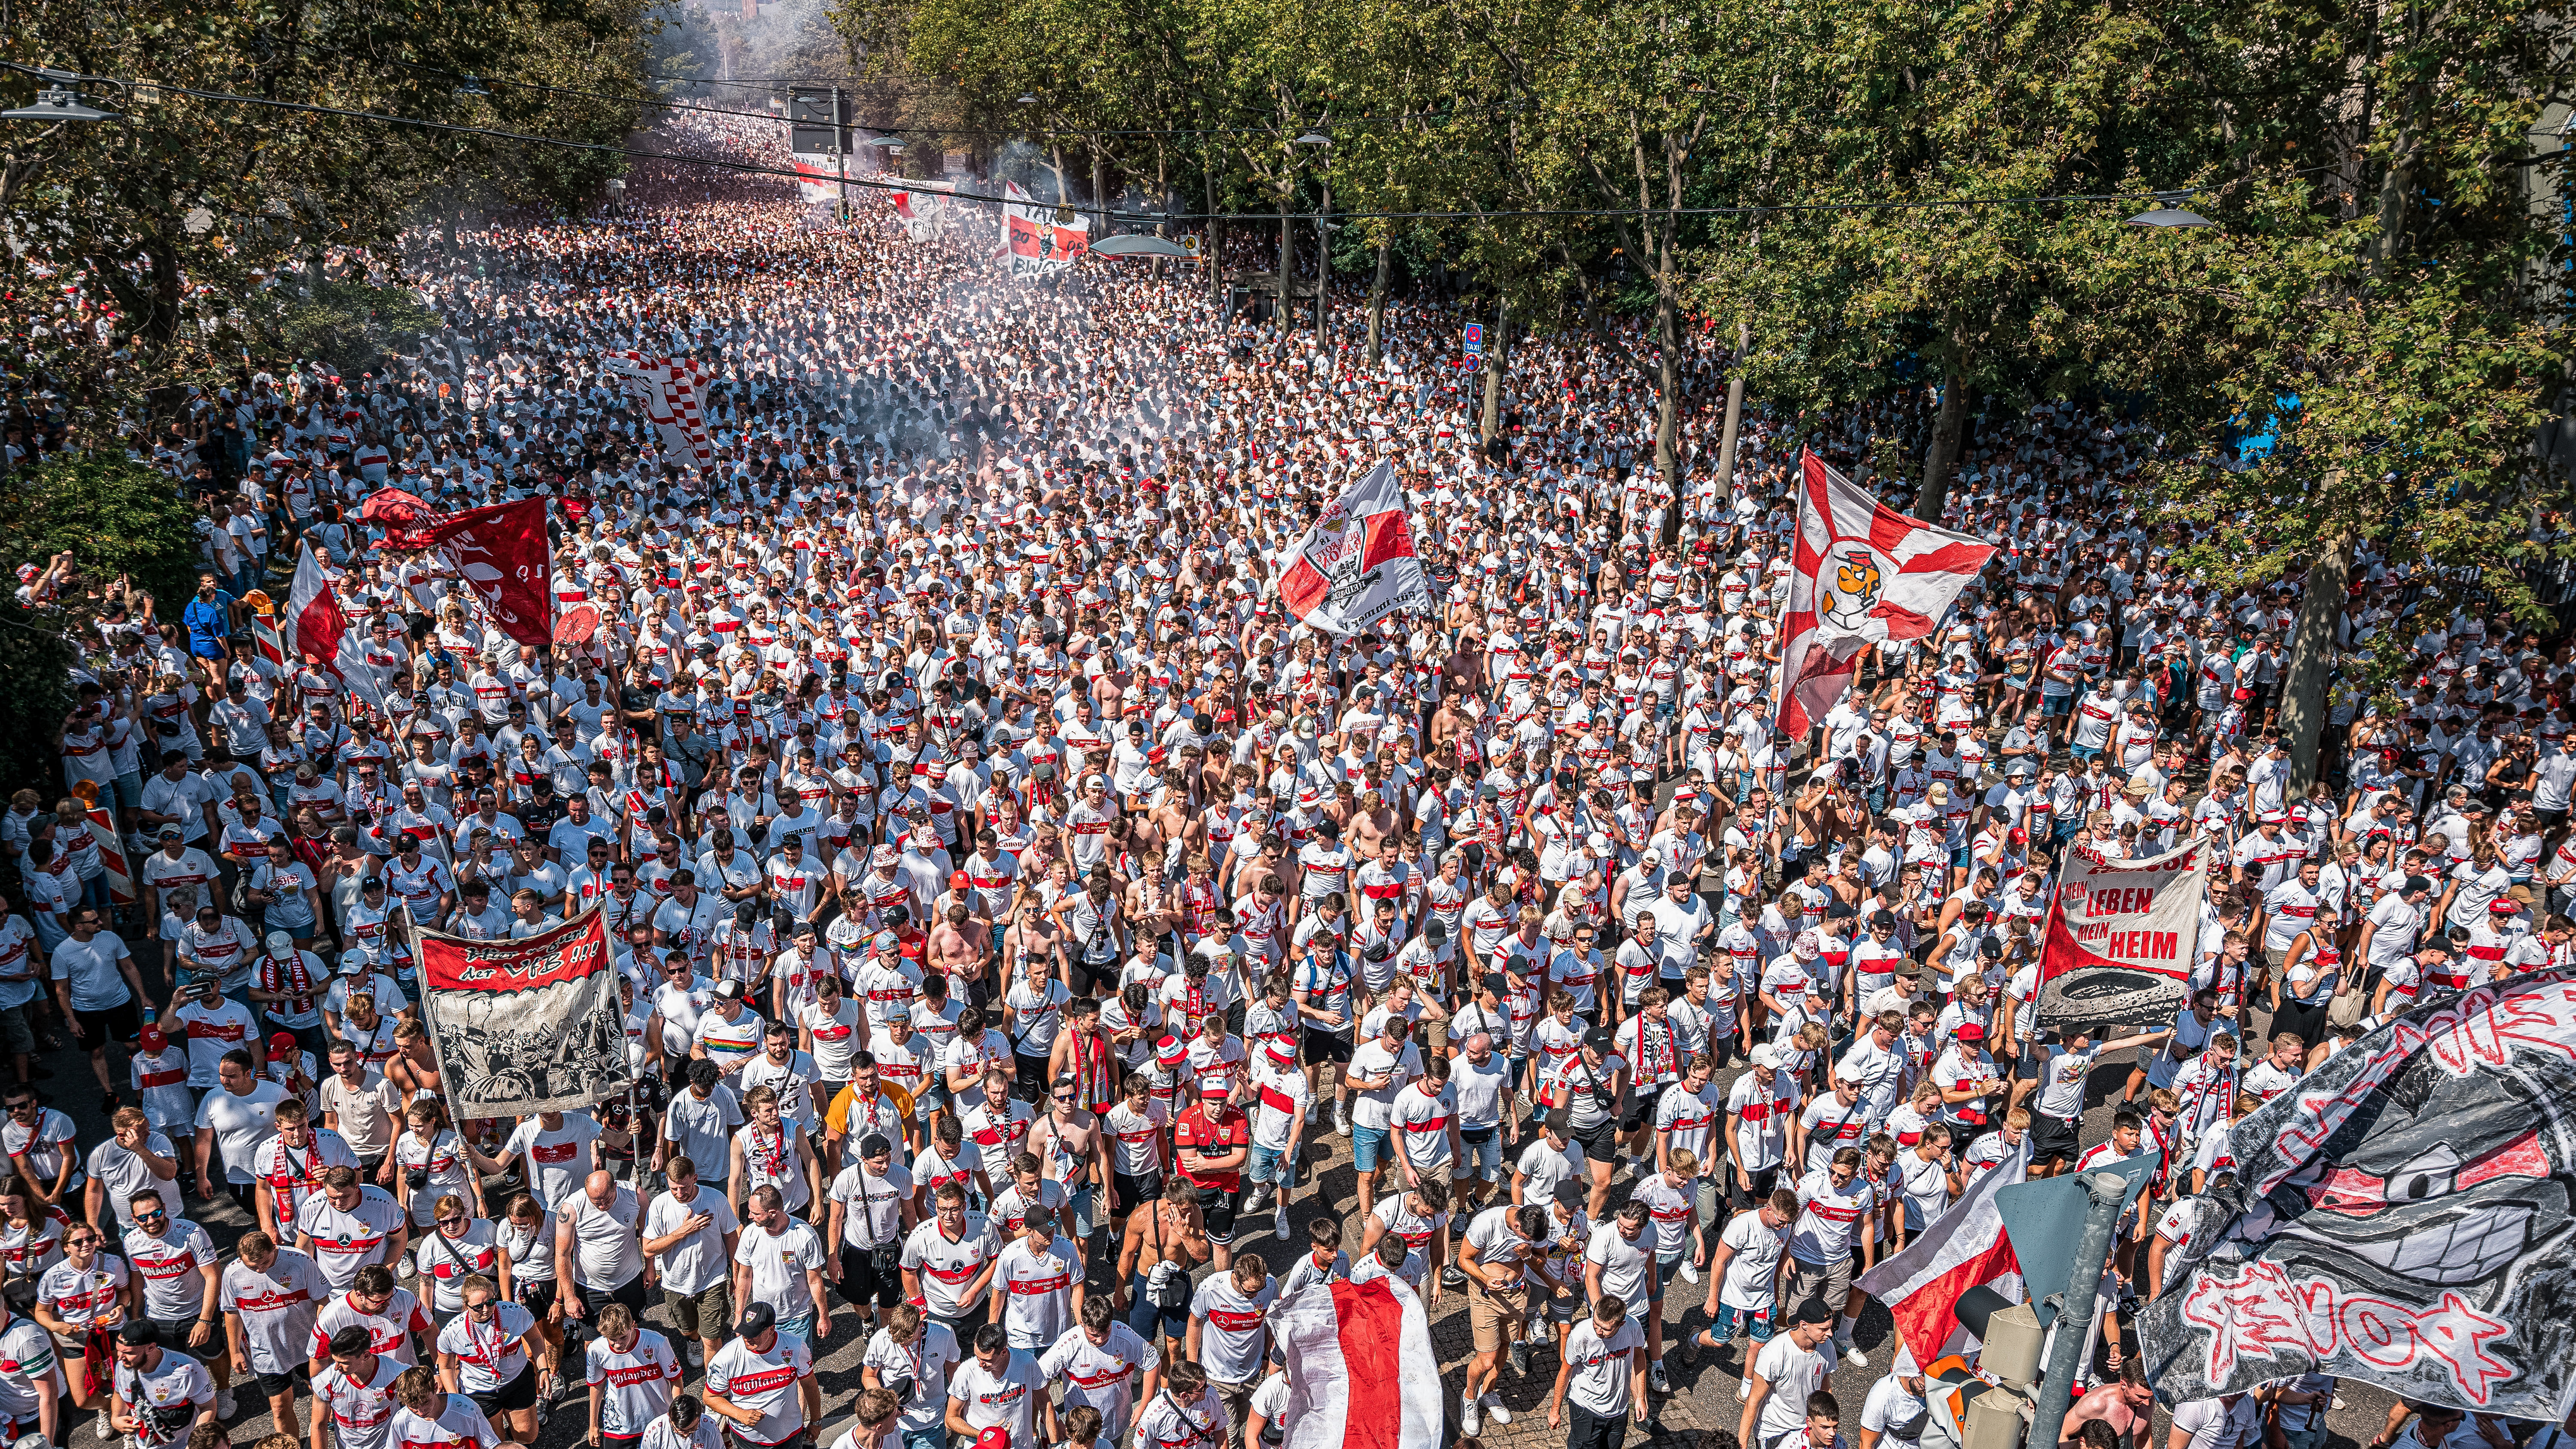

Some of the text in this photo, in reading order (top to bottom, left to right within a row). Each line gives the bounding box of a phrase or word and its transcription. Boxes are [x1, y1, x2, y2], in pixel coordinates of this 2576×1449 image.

[2062, 881, 2087, 901] MEIN
[2086, 887, 2154, 918] LEBEN
[2078, 921, 2110, 942] MEIN
[2108, 931, 2178, 960] HEIM
[459, 967, 496, 981] der
[504, 954, 565, 979] VfB
[244, 1301, 284, 1311] Mercedes-Benz
